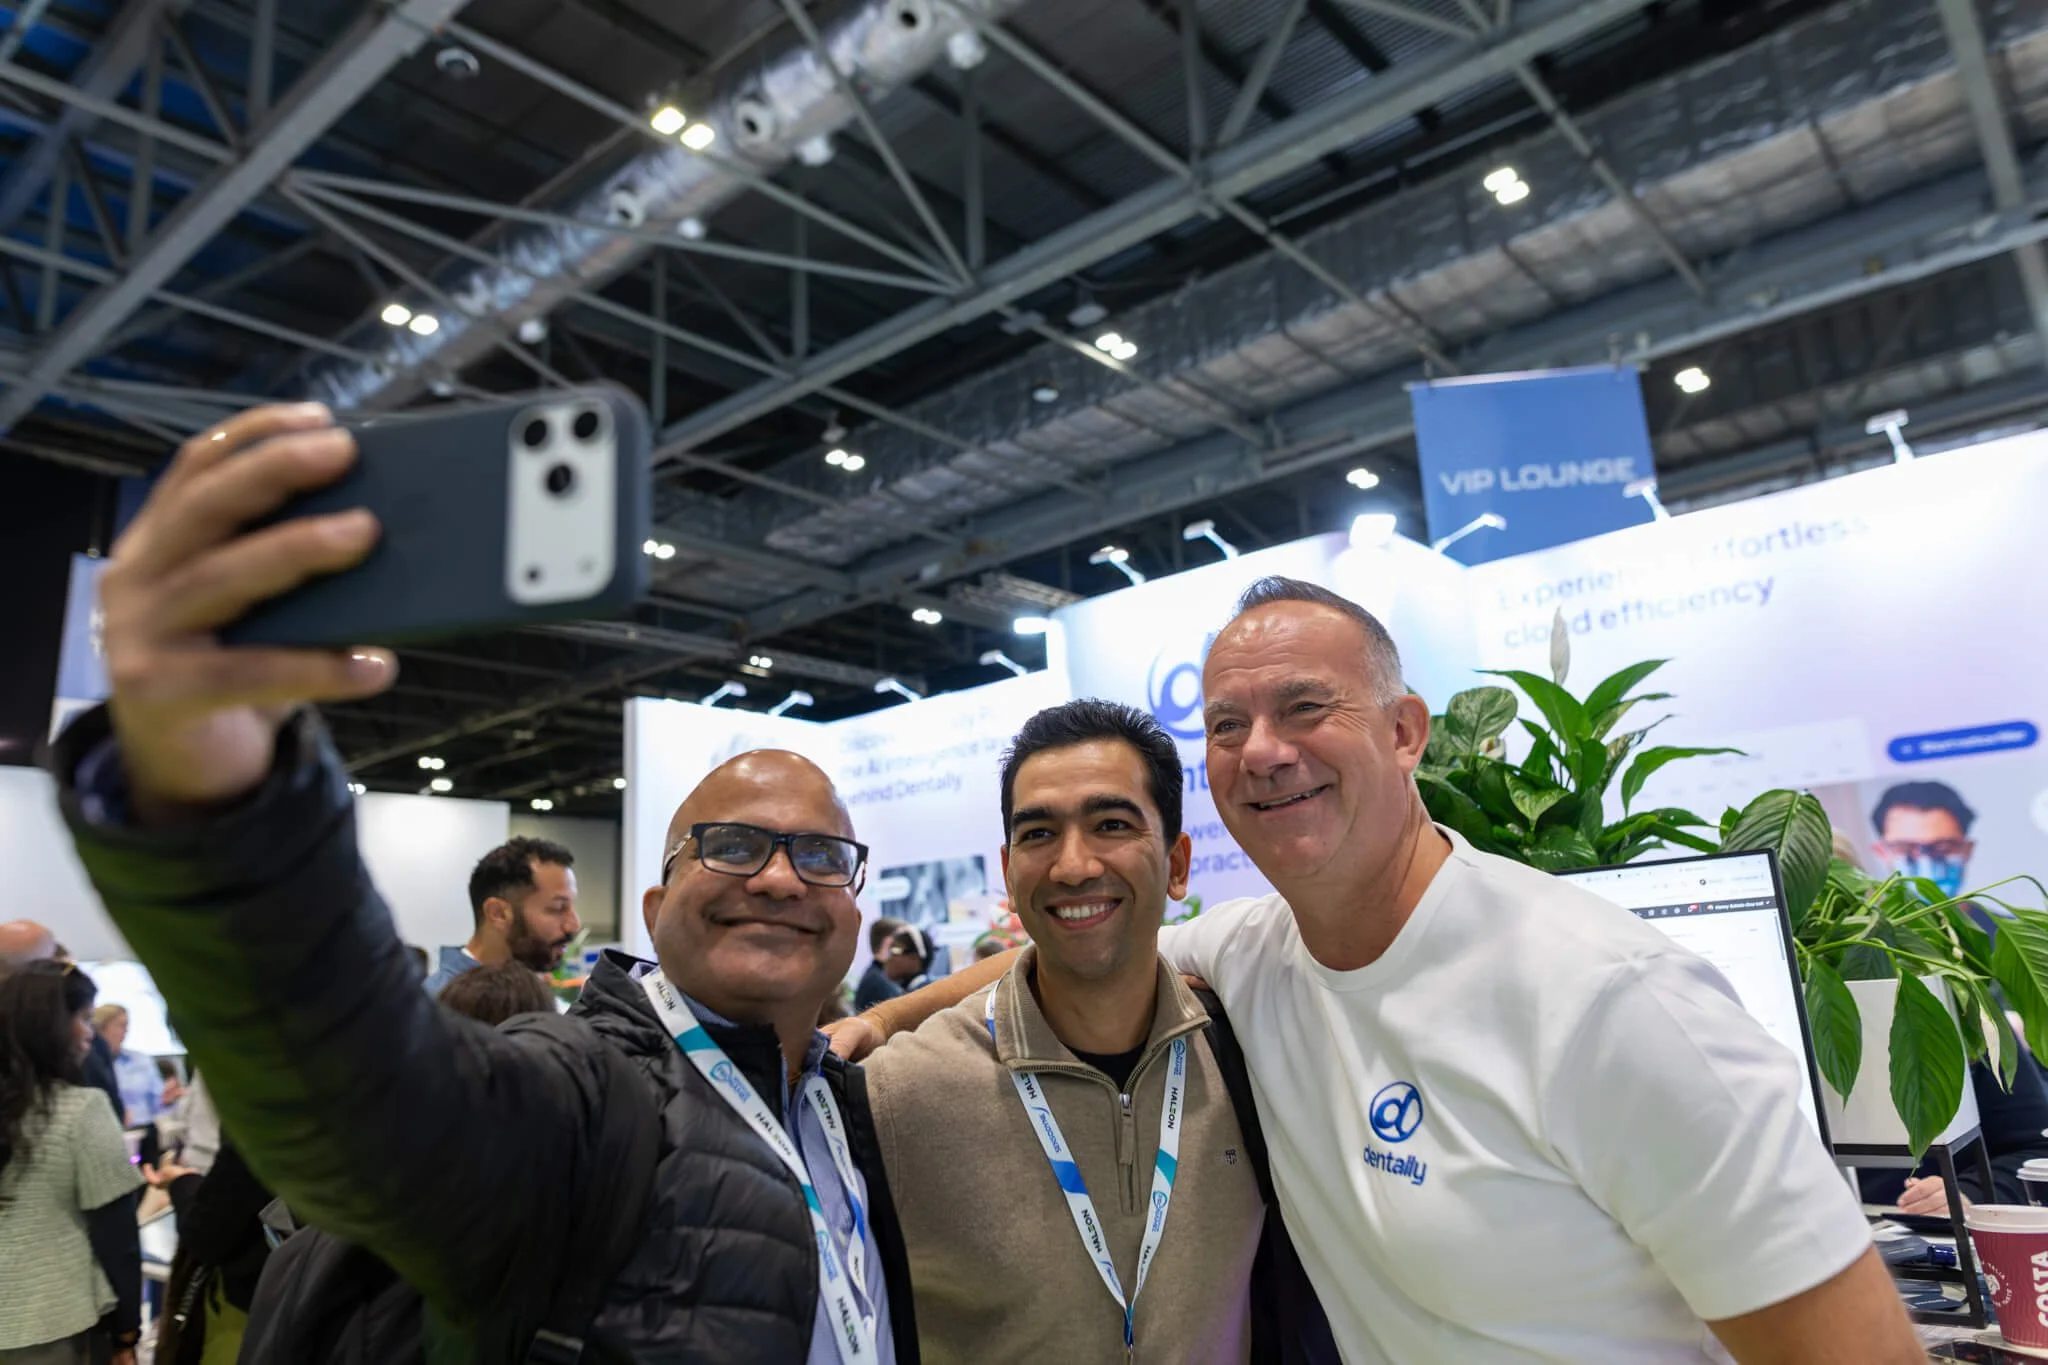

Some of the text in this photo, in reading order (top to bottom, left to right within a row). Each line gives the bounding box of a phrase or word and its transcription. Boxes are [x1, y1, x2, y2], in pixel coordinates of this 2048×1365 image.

[1439, 456, 1636, 496] VIP LOUNGE
[1167, 1087, 1178, 1130] HALEON
[1363, 1144, 1427, 1186] dentally
[1081, 1209, 1102, 1253] HALEON
